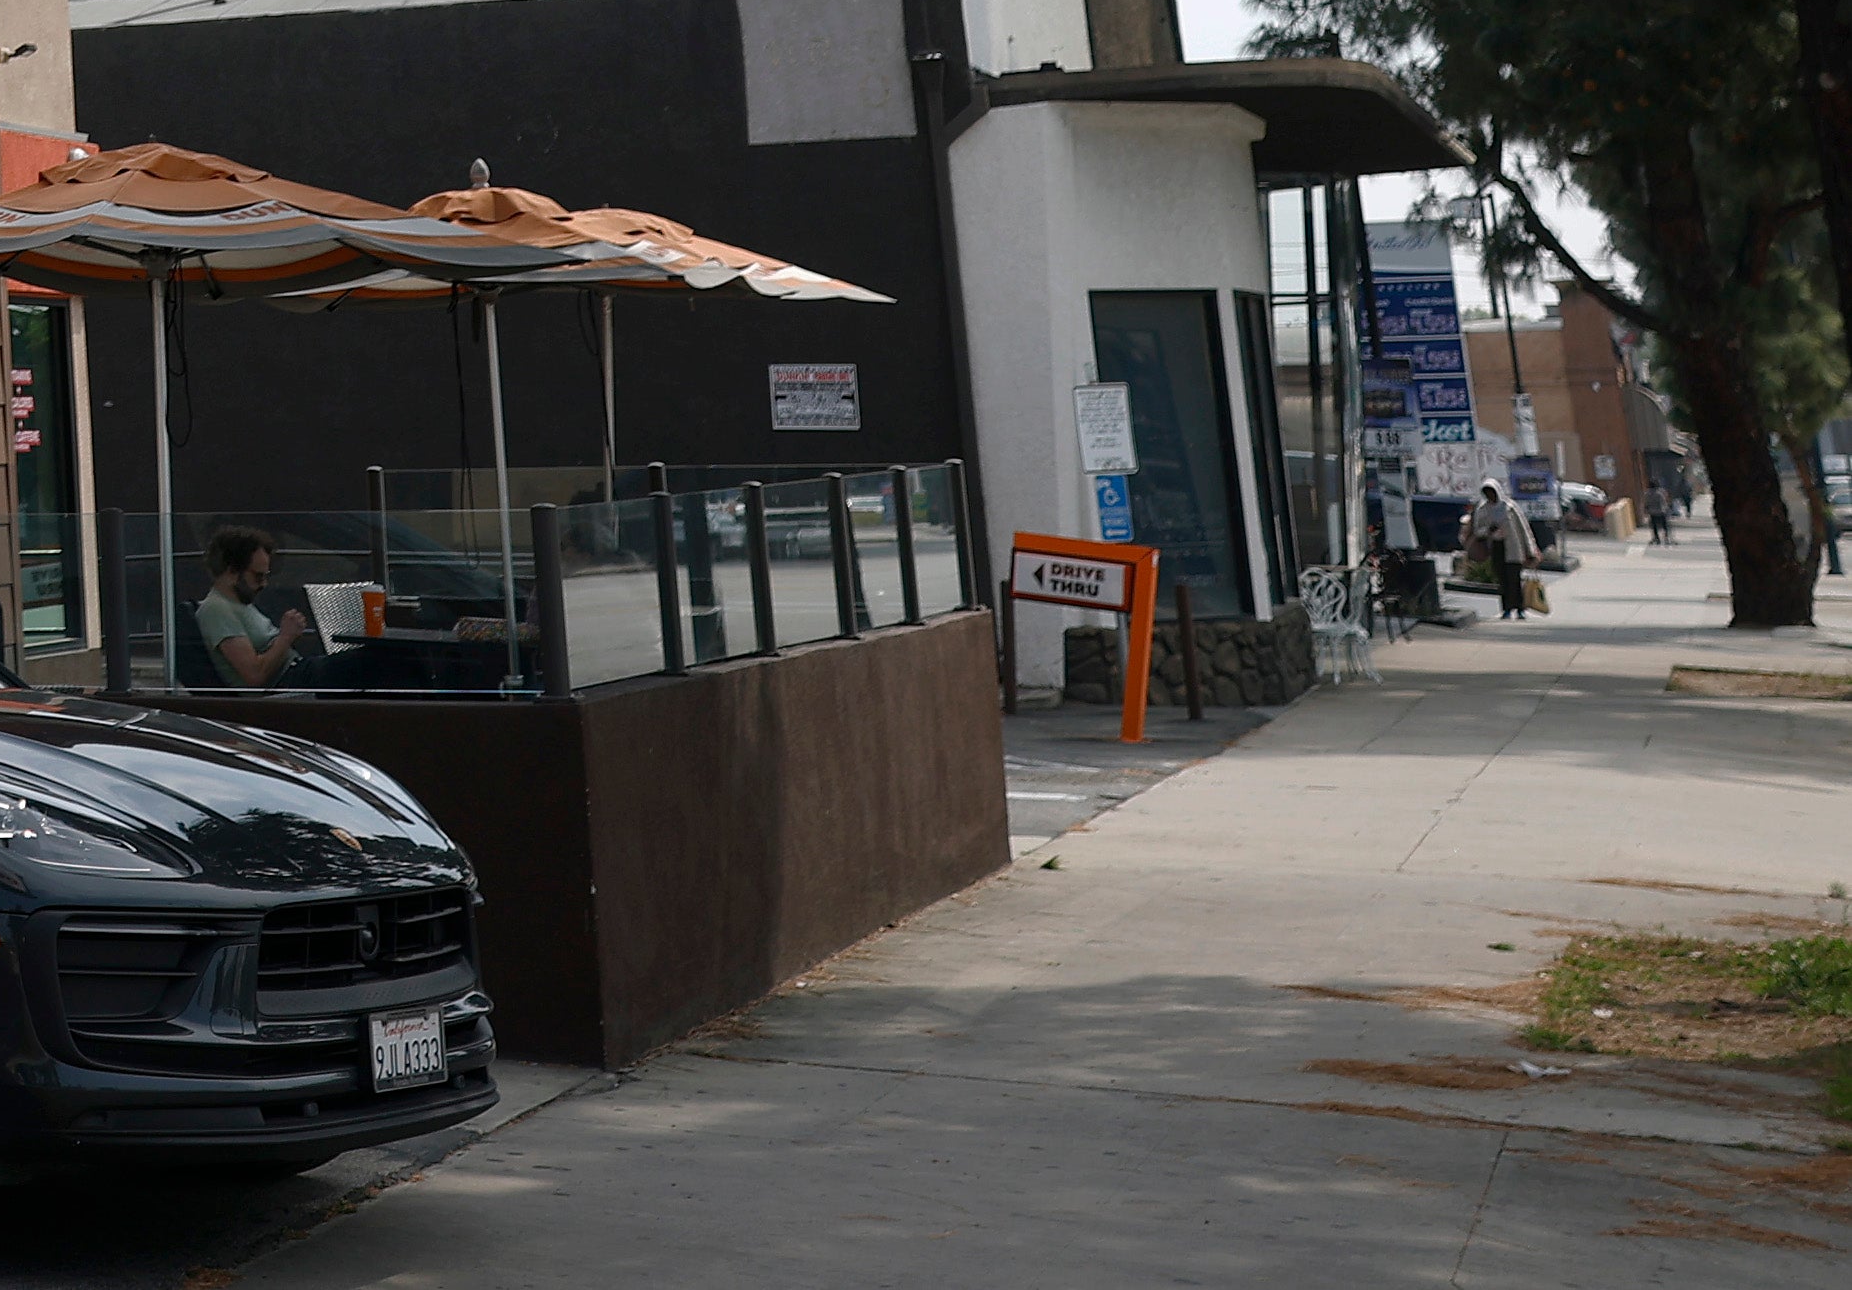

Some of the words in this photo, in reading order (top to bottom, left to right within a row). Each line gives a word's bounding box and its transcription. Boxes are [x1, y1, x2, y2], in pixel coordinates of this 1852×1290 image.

[1050, 563, 1106, 582] DRIVE
[1050, 579, 1100, 597] THRU
[376, 1037, 440, 1080] 9JLA333
